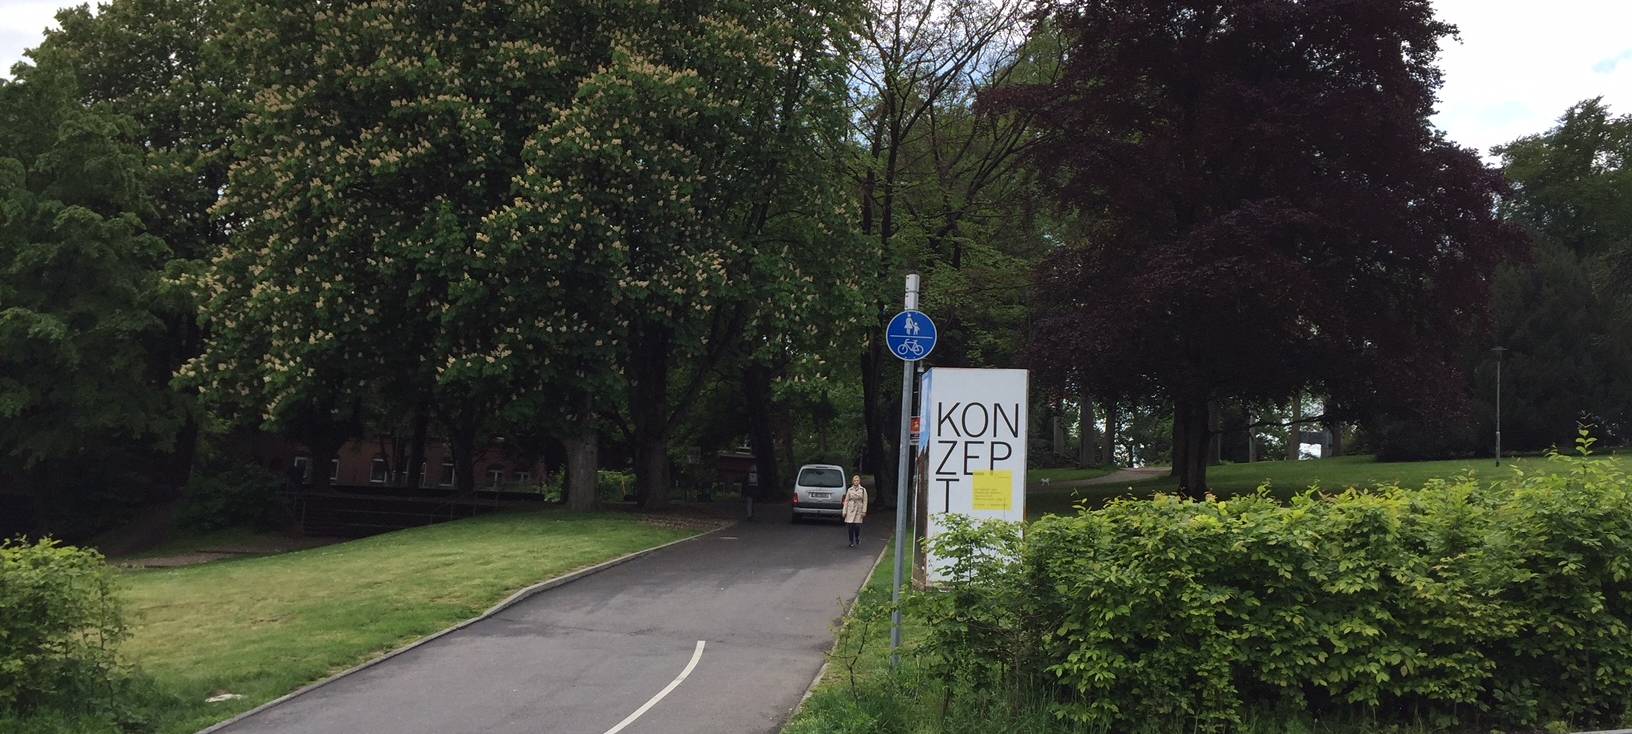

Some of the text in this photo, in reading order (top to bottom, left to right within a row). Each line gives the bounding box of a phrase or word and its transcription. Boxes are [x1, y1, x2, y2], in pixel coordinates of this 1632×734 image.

[937, 402, 1019, 438] KON
[936, 440, 1012, 475] ZEP
[936, 478, 960, 513] T
